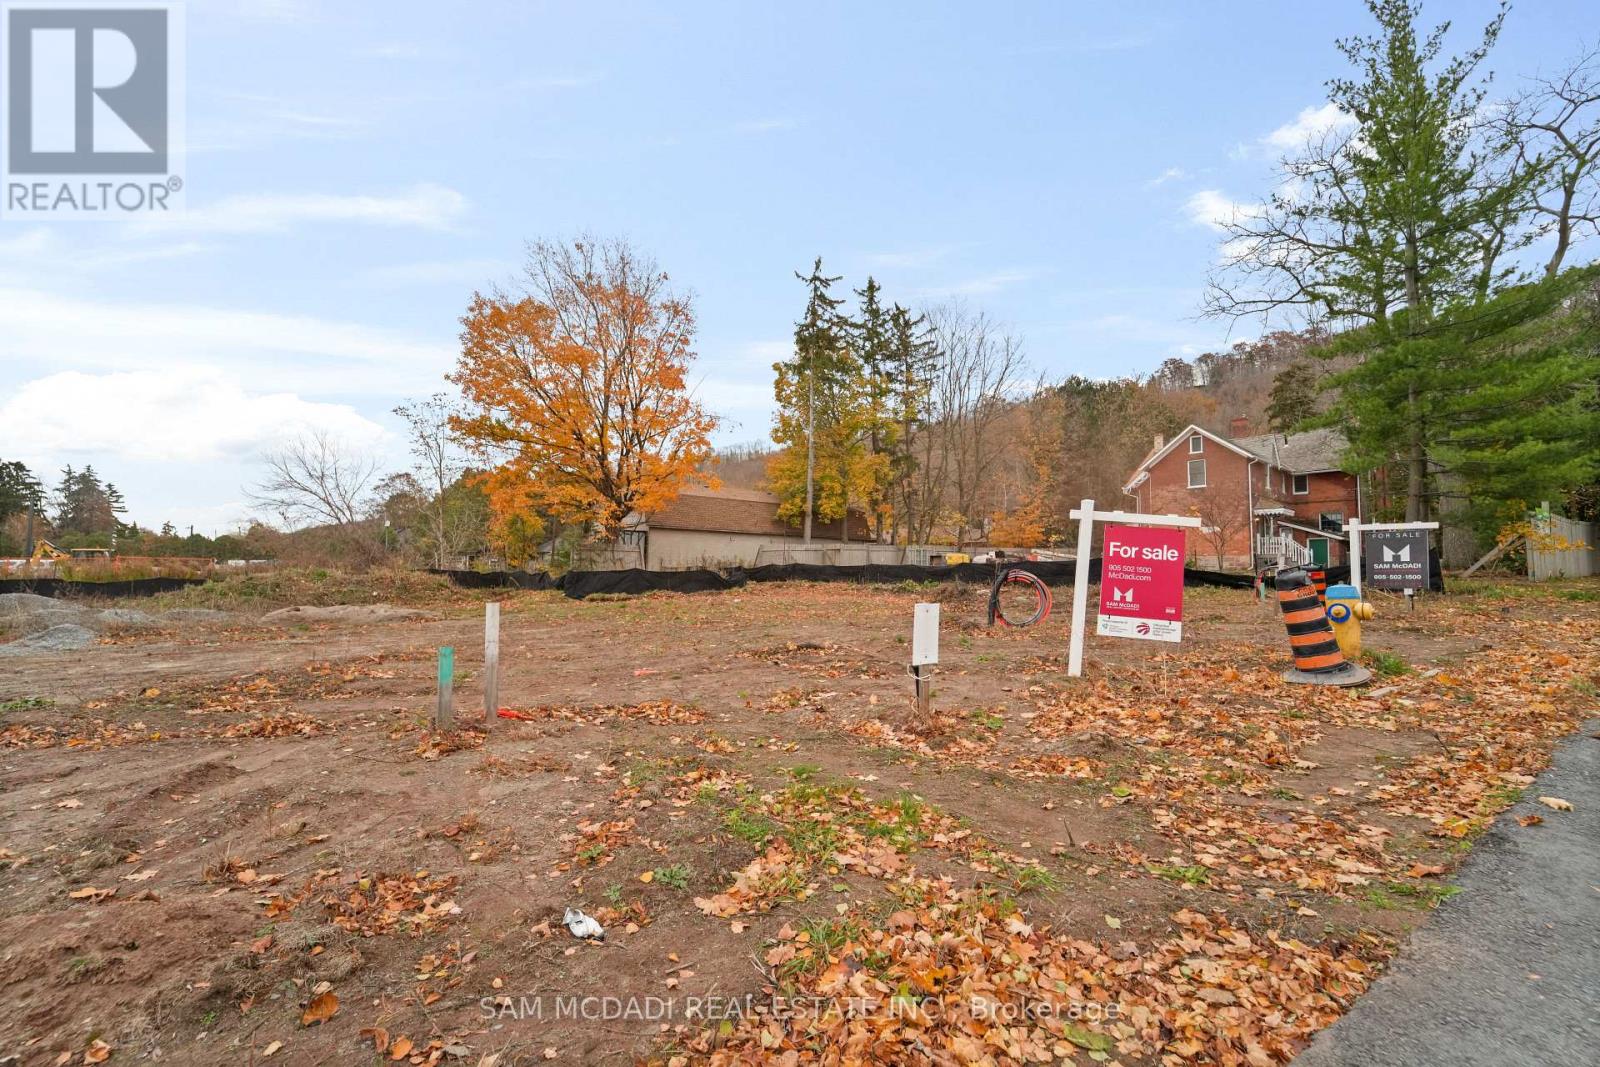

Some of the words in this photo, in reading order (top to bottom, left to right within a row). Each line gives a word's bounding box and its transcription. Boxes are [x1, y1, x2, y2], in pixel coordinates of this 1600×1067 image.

[1109, 541, 1139, 559] For
[1142, 544, 1179, 562] sale
[1136, 566, 1152, 574] 1500
[1108, 571, 1152, 582] McDadi.com
